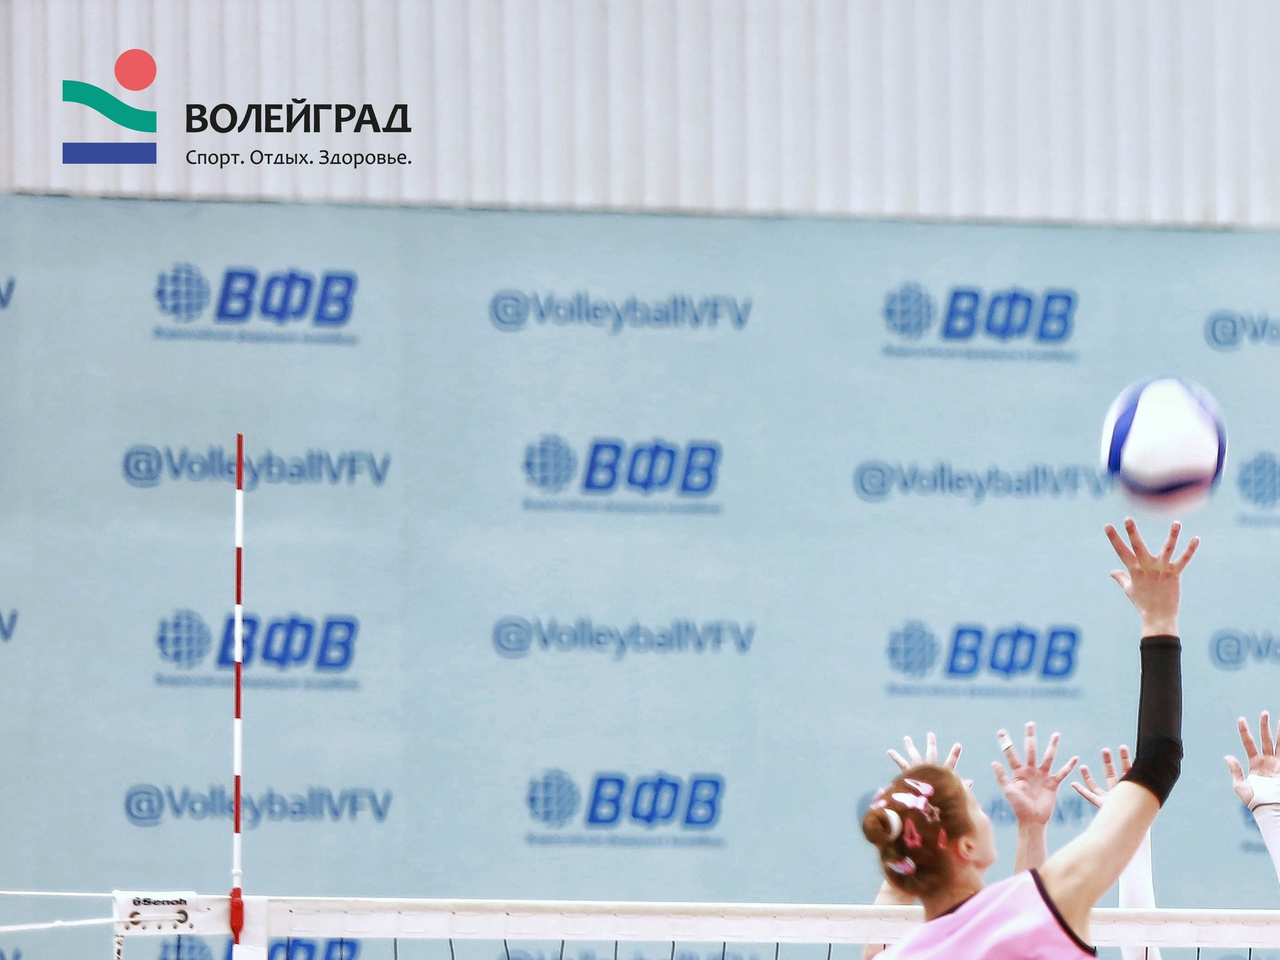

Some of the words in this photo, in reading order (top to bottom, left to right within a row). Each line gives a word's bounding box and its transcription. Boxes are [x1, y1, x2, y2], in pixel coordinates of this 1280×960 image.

[215, 266, 358, 327] ВФВ
[488, 288, 753, 334] @VolleyballVFV
[940, 286, 1078, 344] ВФВ
[583, 435, 724, 496] ВФВ
[216, 613, 360, 673] ВФВ
[492, 615, 756, 662] @VolleyballVFV
[946, 625, 1082, 681] ВФВ
[586, 769, 725, 830] ВФВ
